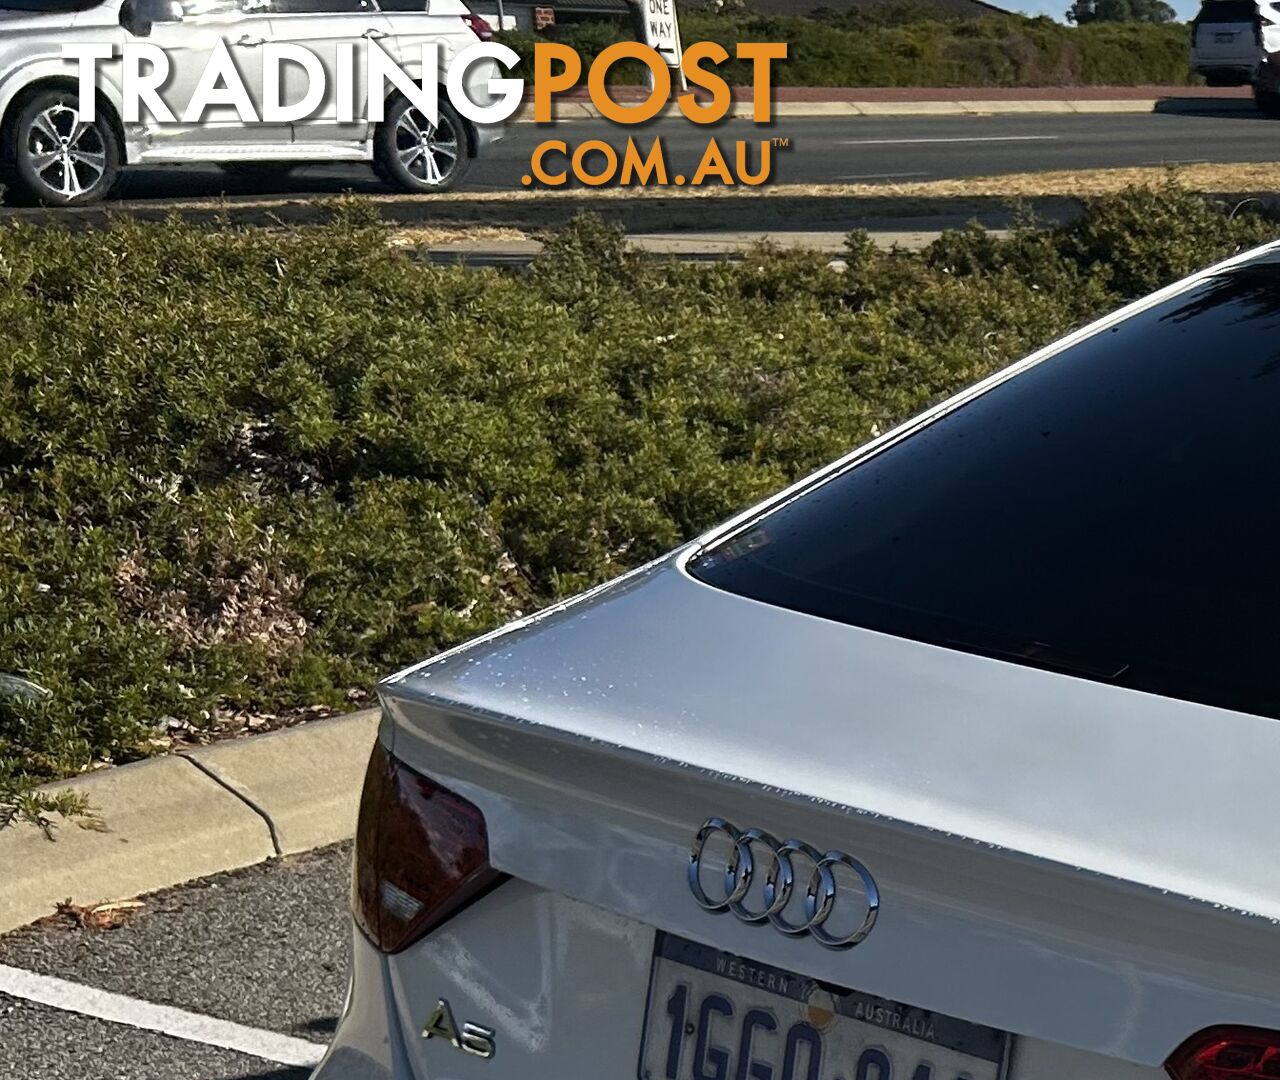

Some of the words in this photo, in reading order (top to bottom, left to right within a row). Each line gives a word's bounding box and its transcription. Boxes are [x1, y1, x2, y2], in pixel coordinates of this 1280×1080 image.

[649, 0, 670, 15] ONE
[650, 21, 672, 38] WAY
[715, 957, 789, 994] WESTERN
[855, 1001, 937, 1041] AUSTRALIA
[421, 997, 496, 1059] A5
